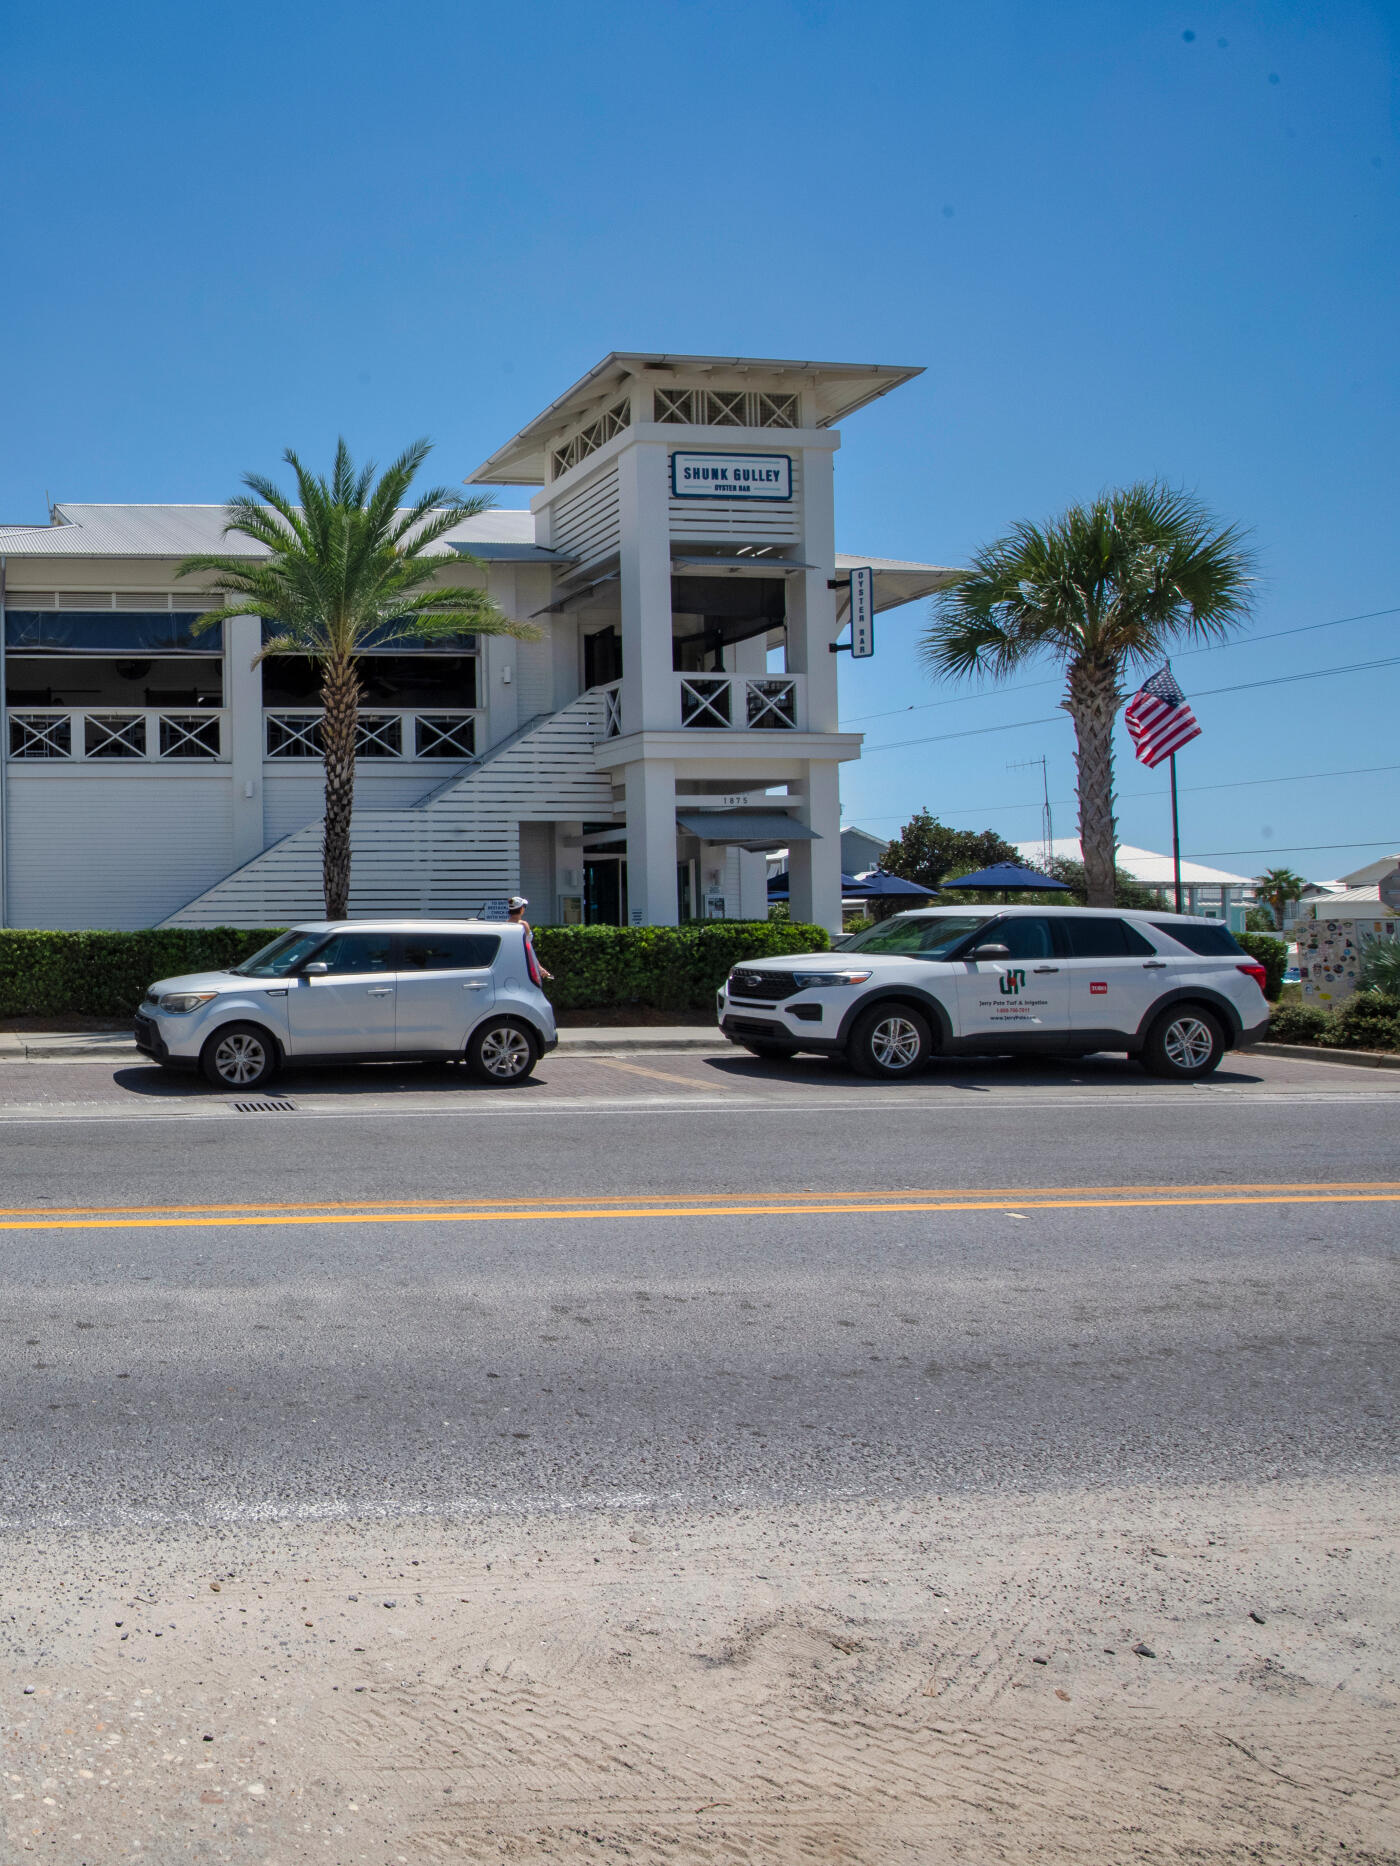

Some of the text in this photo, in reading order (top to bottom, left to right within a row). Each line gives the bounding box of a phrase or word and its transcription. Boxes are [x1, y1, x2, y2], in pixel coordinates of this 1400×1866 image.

[684, 466, 780, 482] SHUNK GULLEY
[857, 571, 865, 622] OYSTER
